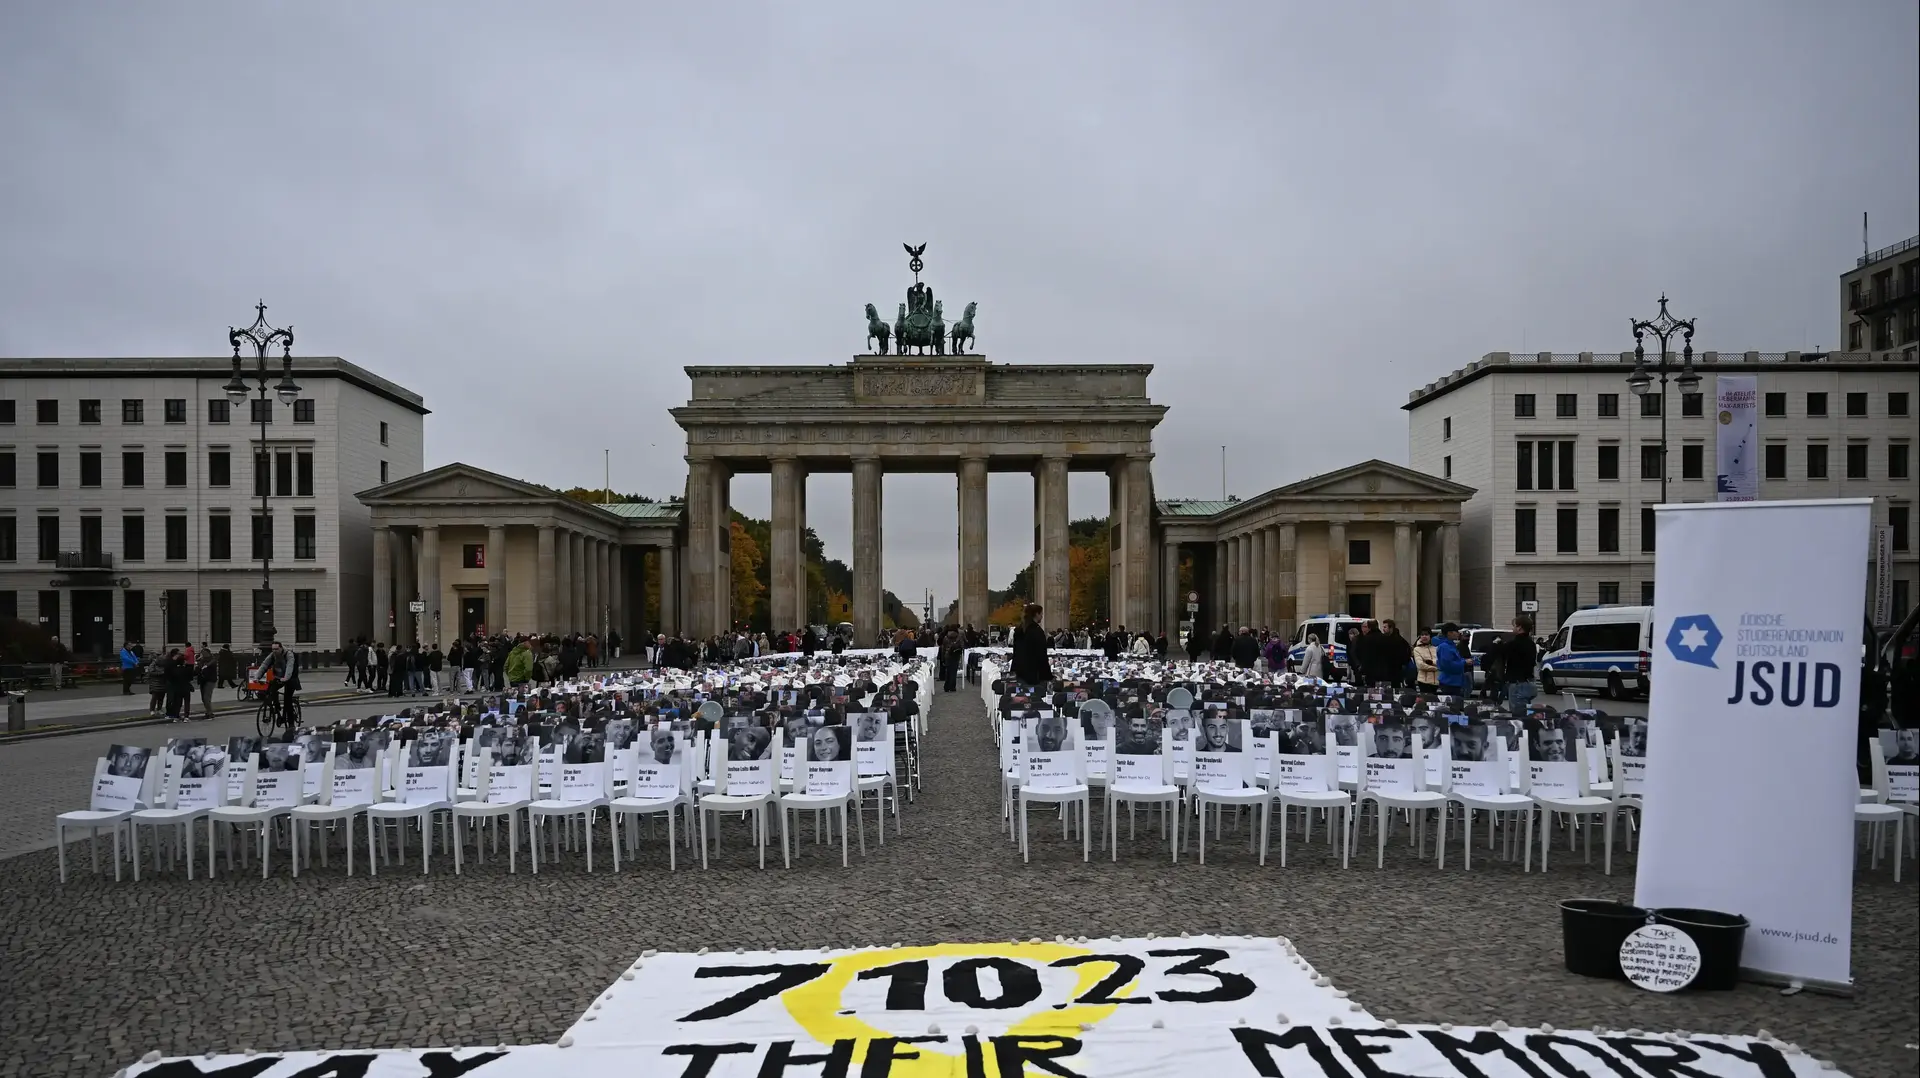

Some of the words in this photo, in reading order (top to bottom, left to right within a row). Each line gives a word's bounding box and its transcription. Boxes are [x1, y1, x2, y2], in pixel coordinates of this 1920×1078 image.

[1739, 612, 1785, 626] JÜDISCHE
[1737, 629, 1843, 643] STUDIERENDENUNION
[1737, 645, 1808, 657] DEUTSCHLAND
[1727, 661, 1841, 708] JSUD
[1651, 928, 1676, 940] TAKE
[1760, 927, 1838, 944] www.jsud.de
[1634, 941, 1666, 949] Judaism
[1679, 945, 1686, 953] is
[1630, 973, 1650, 982] alive
[1655, 975, 1682, 986] forever
[662, 1033, 1087, 1078] THEIR
[1229, 1026, 1795, 1078] MEMORY
